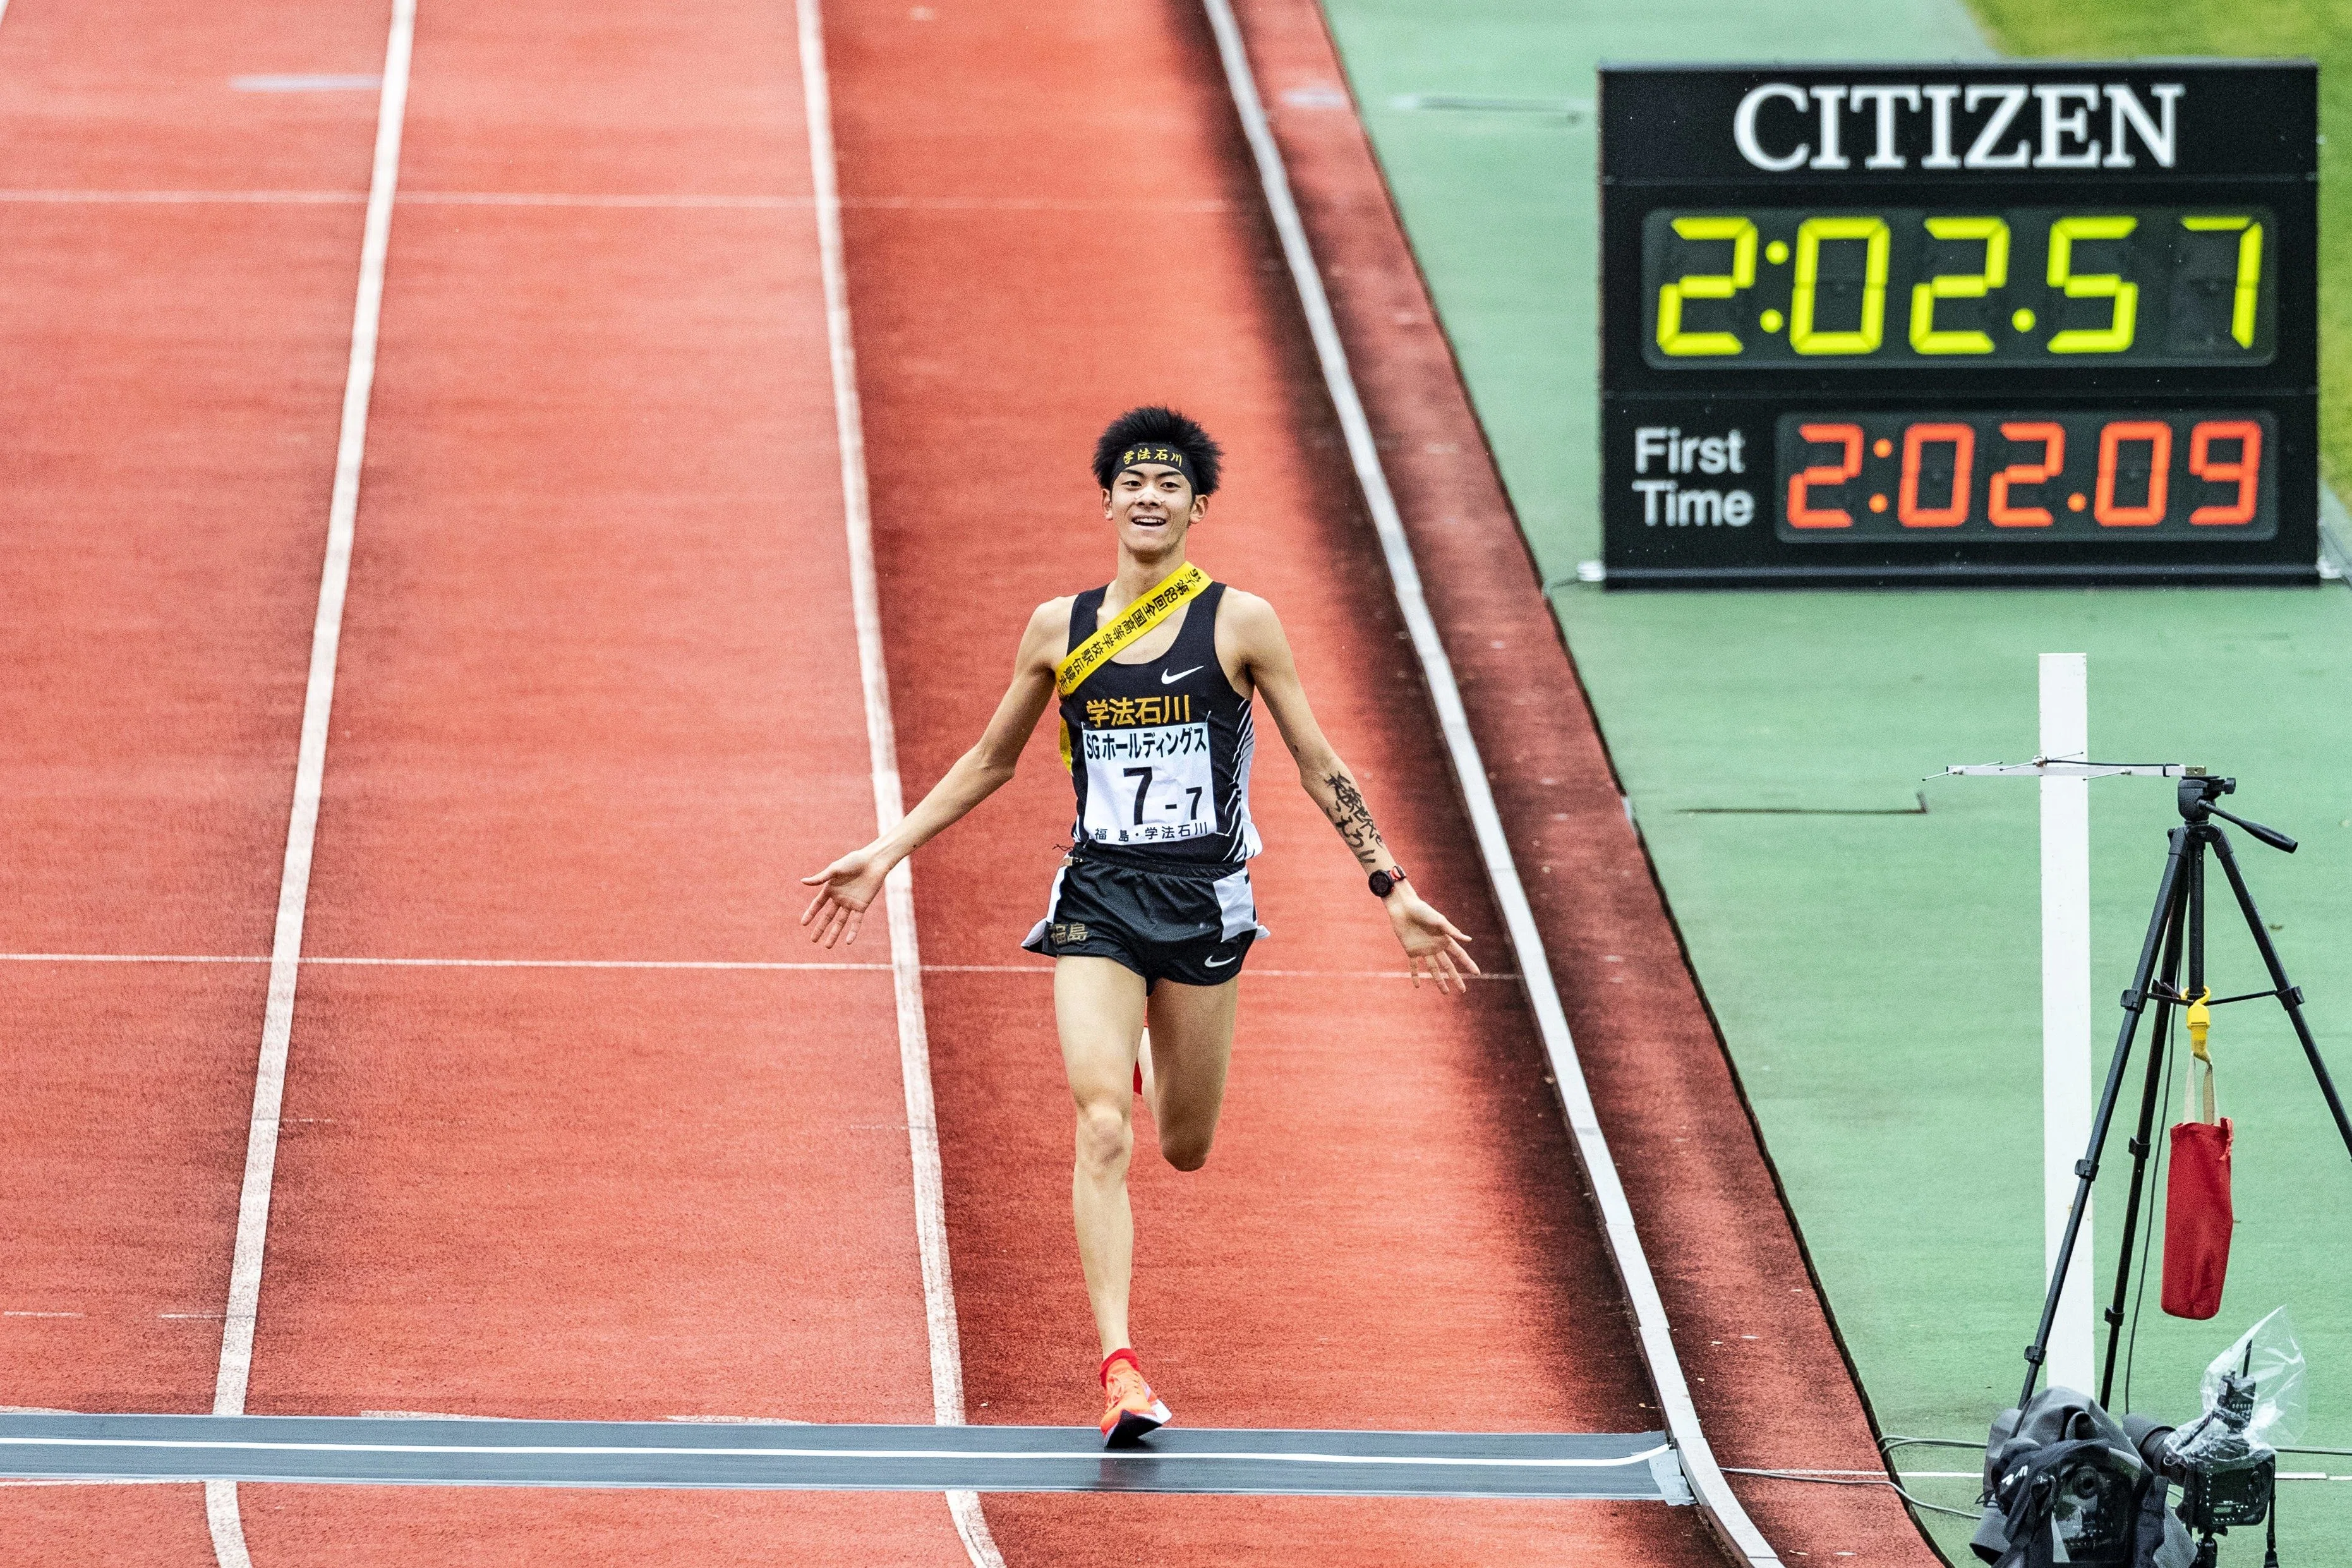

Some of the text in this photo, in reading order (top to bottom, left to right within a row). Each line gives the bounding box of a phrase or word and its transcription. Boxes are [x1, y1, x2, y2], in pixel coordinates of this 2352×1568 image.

[1734, 83, 2185, 171] CITIZEN
[1656, 215, 2263, 356] 2:02.57
[1123, 447, 1182, 467] 学法石川
[1635, 427, 1744, 474] First
[1787, 420, 2262, 529] 2:02.09
[1632, 480, 1754, 527] Time
[1086, 695, 1190, 728] 学法石川
[1086, 727, 1207, 761] SGホールディングス
